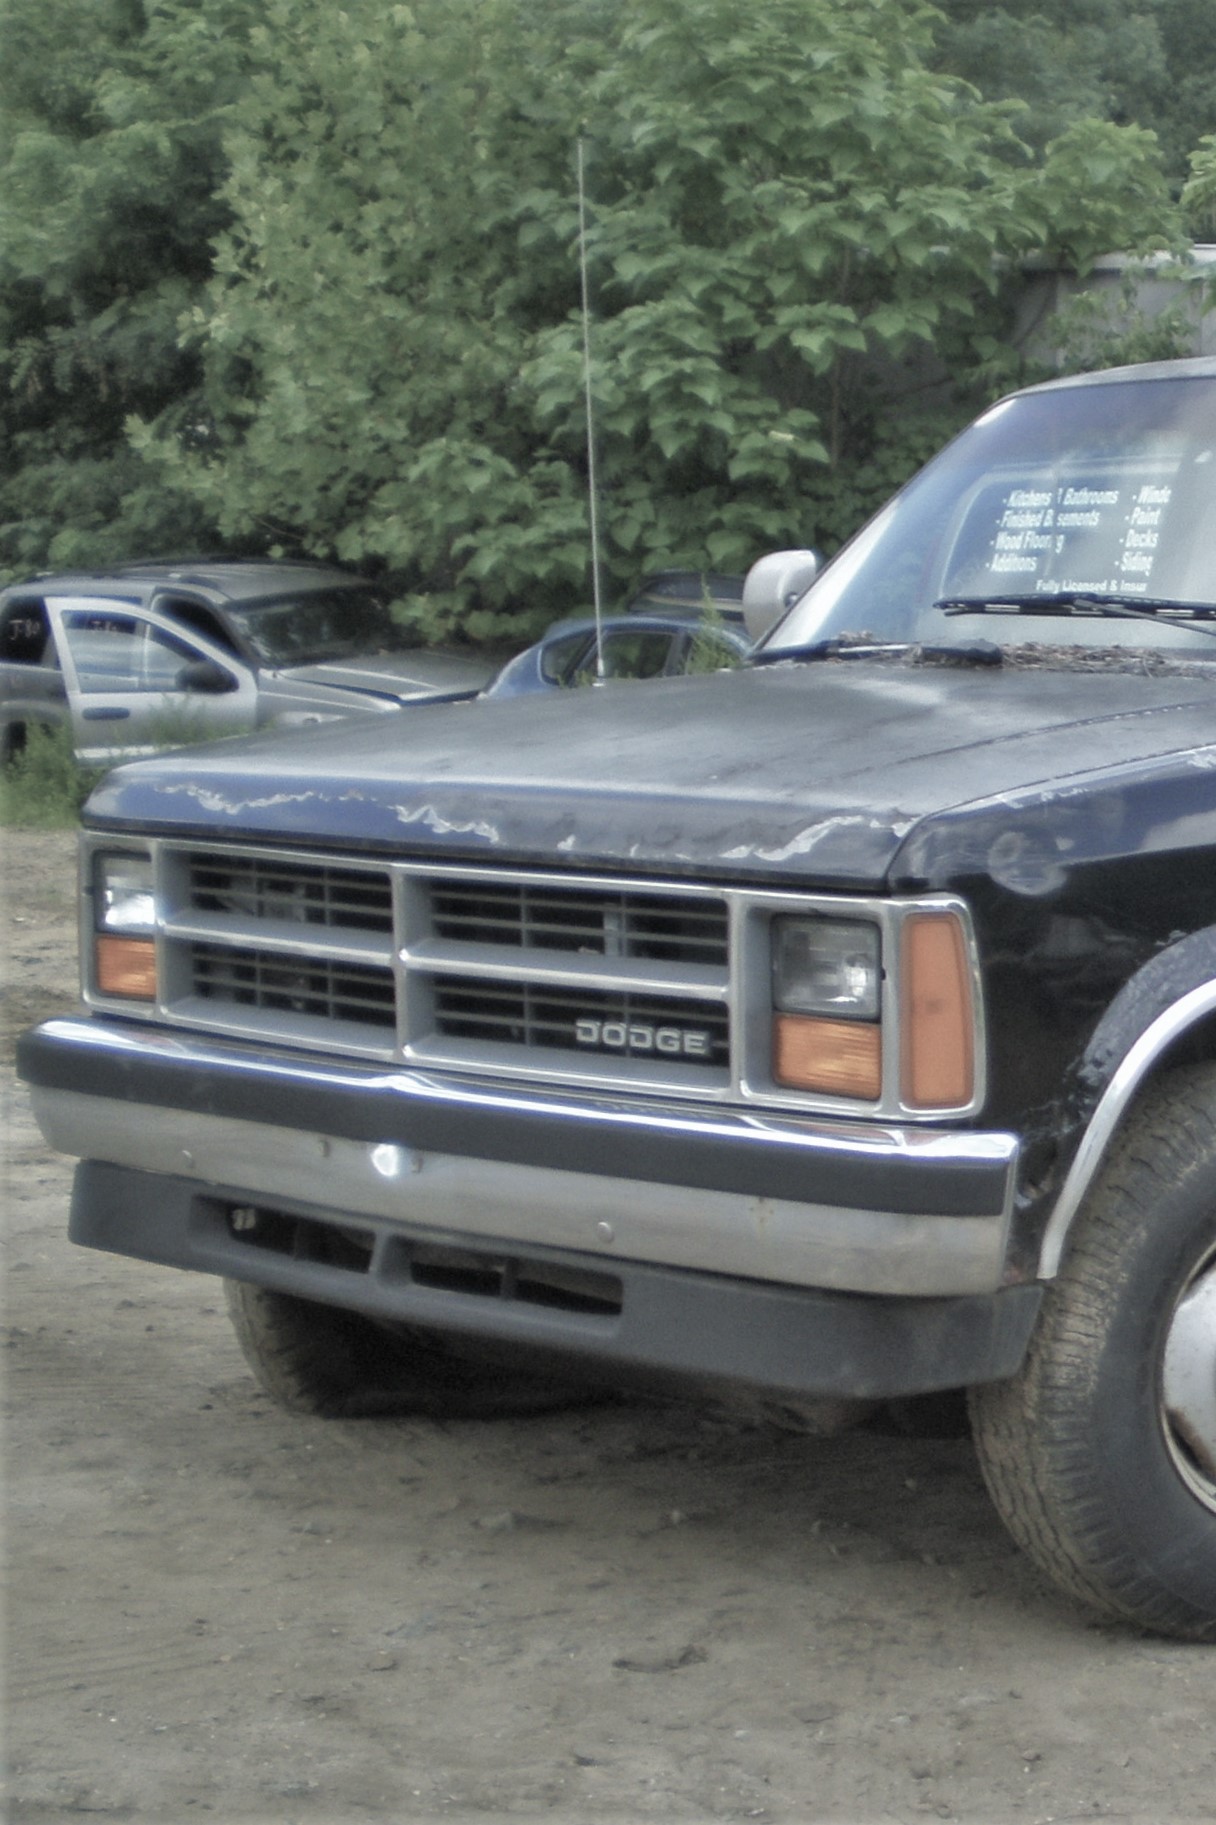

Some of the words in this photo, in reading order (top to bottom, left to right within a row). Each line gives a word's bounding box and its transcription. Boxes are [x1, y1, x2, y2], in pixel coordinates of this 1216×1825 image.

[1063, 487, 1120, 505] Bathrooms
[1000, 509, 1045, 528] Finished
[995, 532, 1024, 550] Wood
[1125, 528, 1159, 548] Decks
[990, 553, 1038, 572] Additions
[1120, 551, 1154, 577] Siding
[1035, 579, 1060, 594] Fully
[1062, 578, 1108, 592] Licensed
[575, 1018, 711, 1056] DODGE
